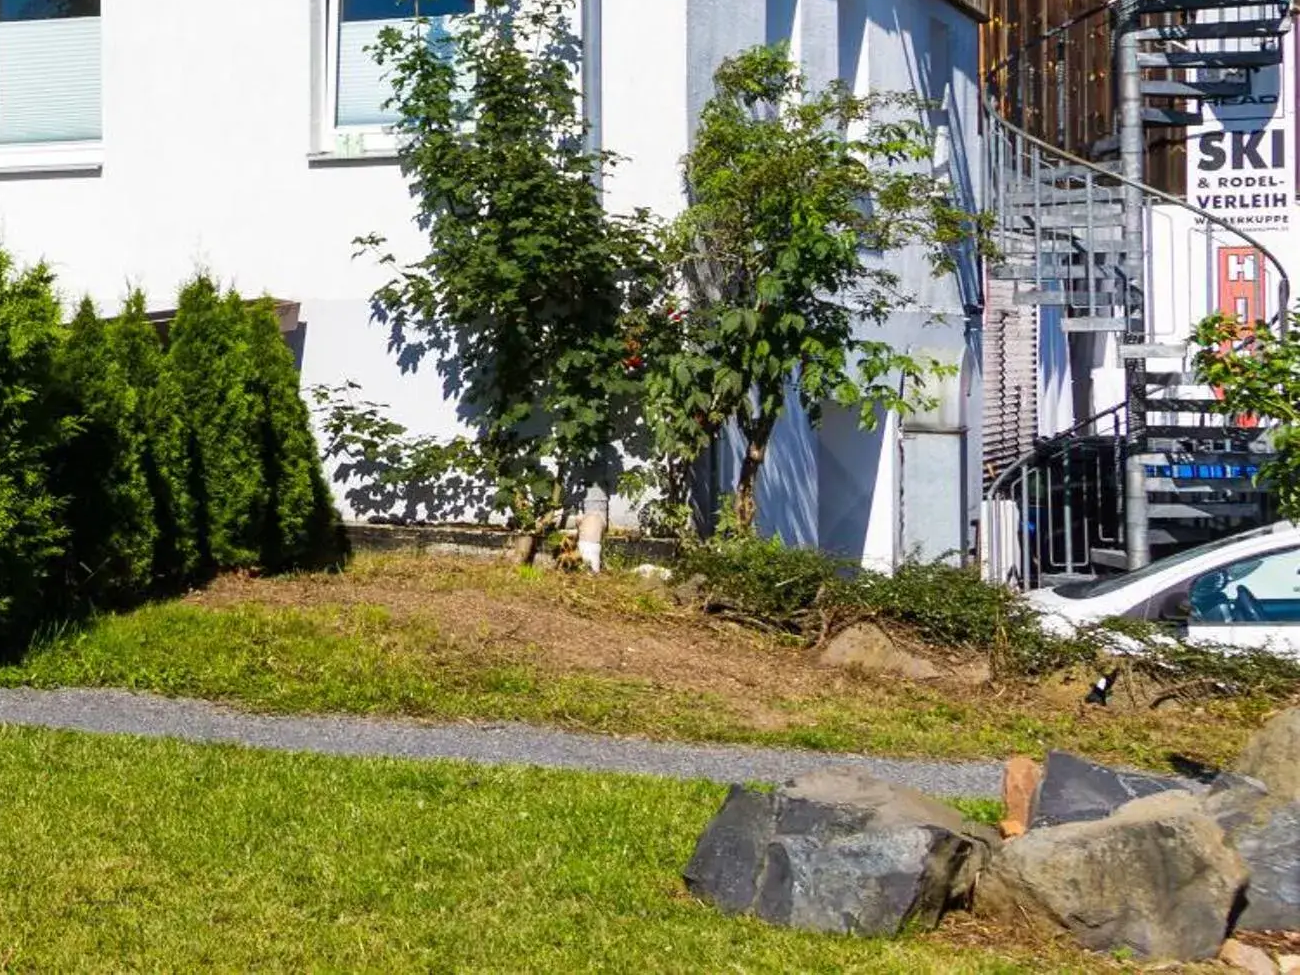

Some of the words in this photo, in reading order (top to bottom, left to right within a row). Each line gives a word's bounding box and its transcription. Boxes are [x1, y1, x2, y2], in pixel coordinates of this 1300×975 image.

[1197, 128, 1285, 171] SKI
[1198, 177, 1210, 188] &
[1218, 175, 1285, 188] RODEL-
[1196, 193, 1287, 209] VERLEIH
